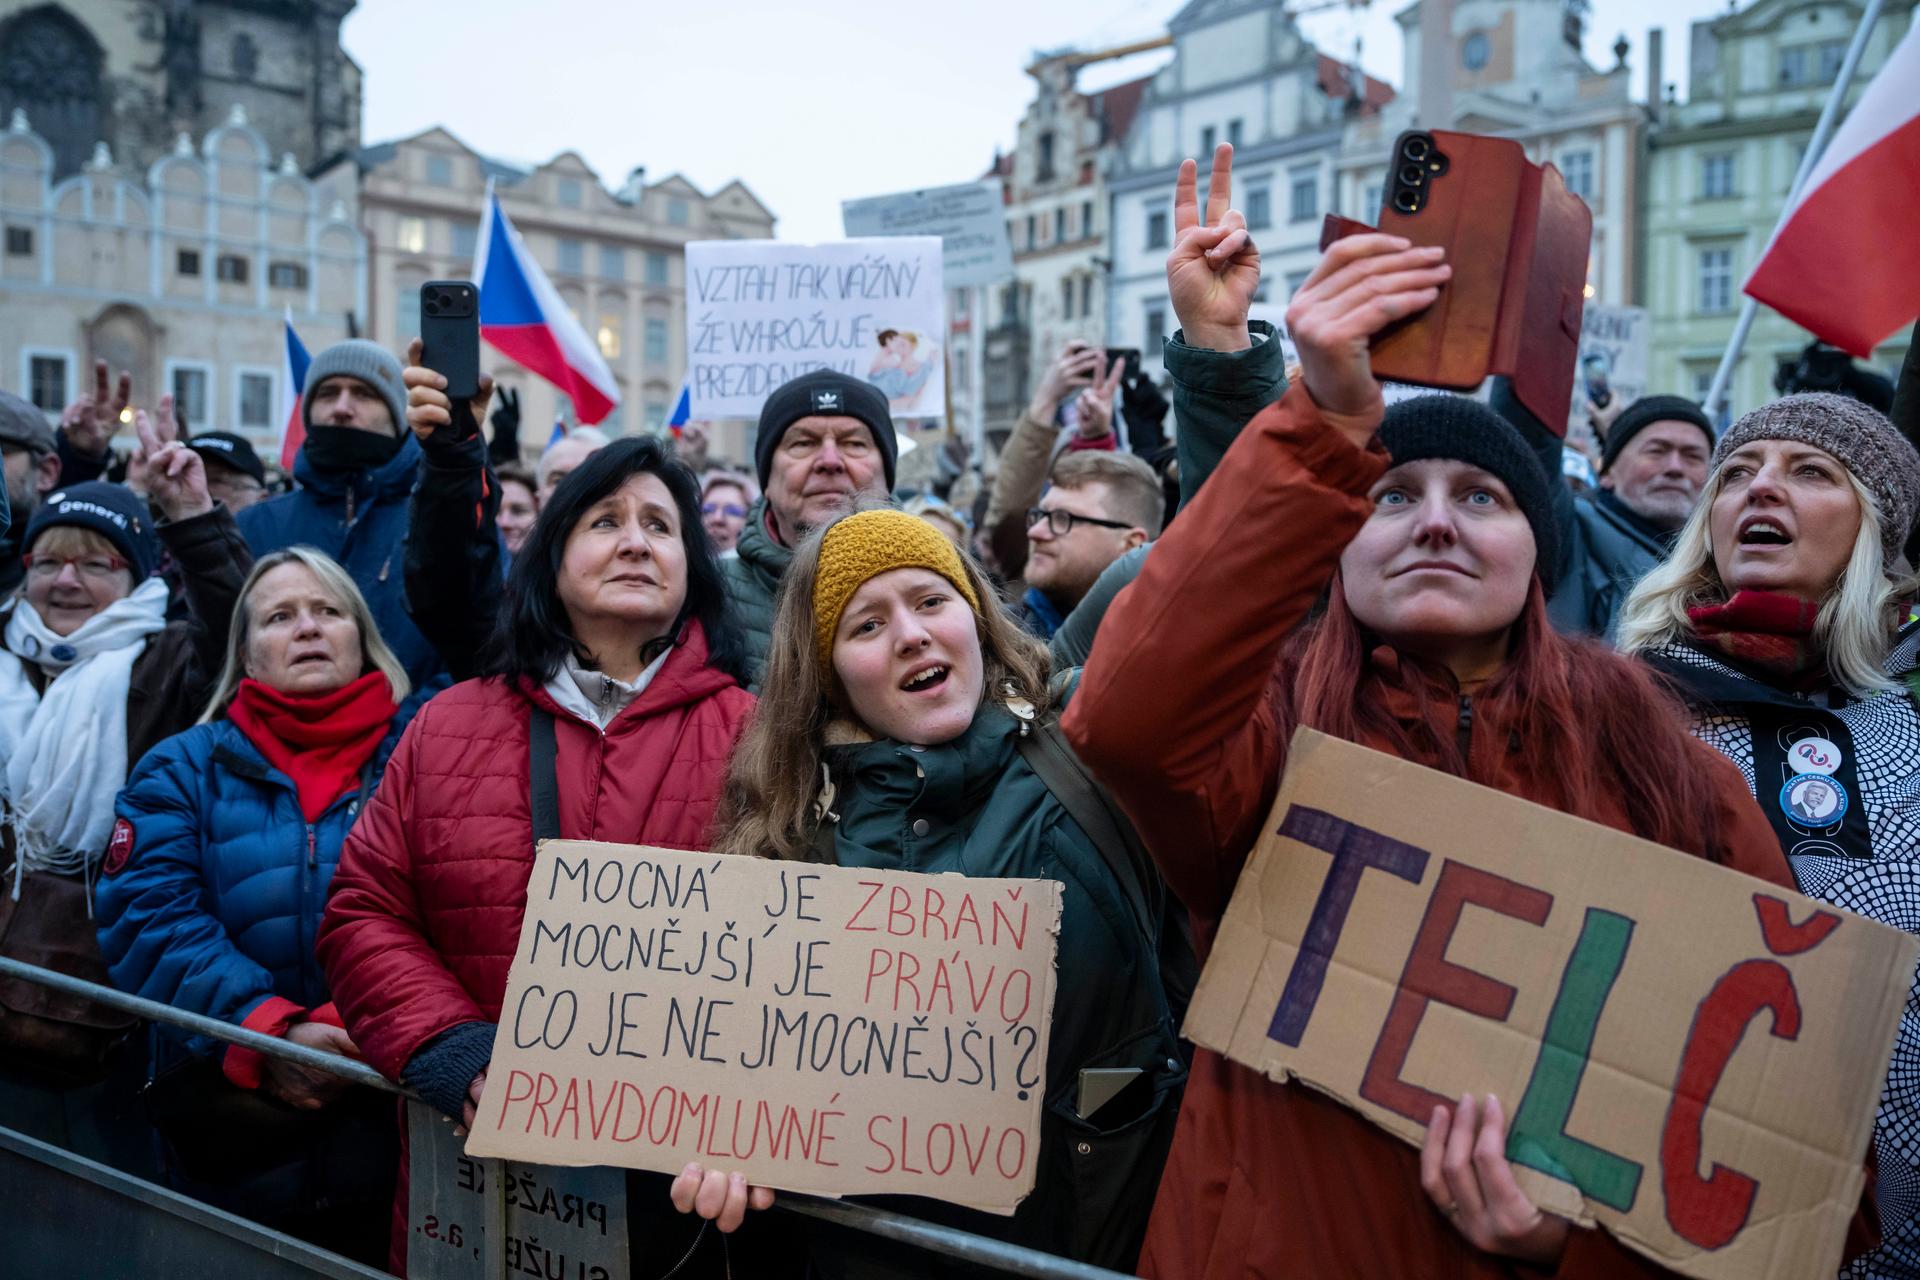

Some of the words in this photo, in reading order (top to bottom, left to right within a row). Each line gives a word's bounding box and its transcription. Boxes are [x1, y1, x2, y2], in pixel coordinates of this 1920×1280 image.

[694, 265, 778, 302] VZTAH
[784, 263, 829, 300] TAK
[837, 254, 921, 300] VÁŽNÝ
[693, 311, 725, 353] ŽE
[549, 857, 721, 912] MOCNÁ
[765, 871, 821, 921] JE
[845, 882, 1028, 950] ZBRAŇ
[531, 919, 778, 988] MOCNĚJŠÍ
[774, 940, 831, 997] JE
[864, 948, 1031, 1024] PRÁVO
[514, 984, 577, 1050] CO
[589, 993, 648, 1058] JE
[1267, 803, 1842, 1250] TELČ
[498, 1070, 845, 1167] PRAVDOMLUVNÉ
[865, 1115, 1026, 1180] SLOVO
